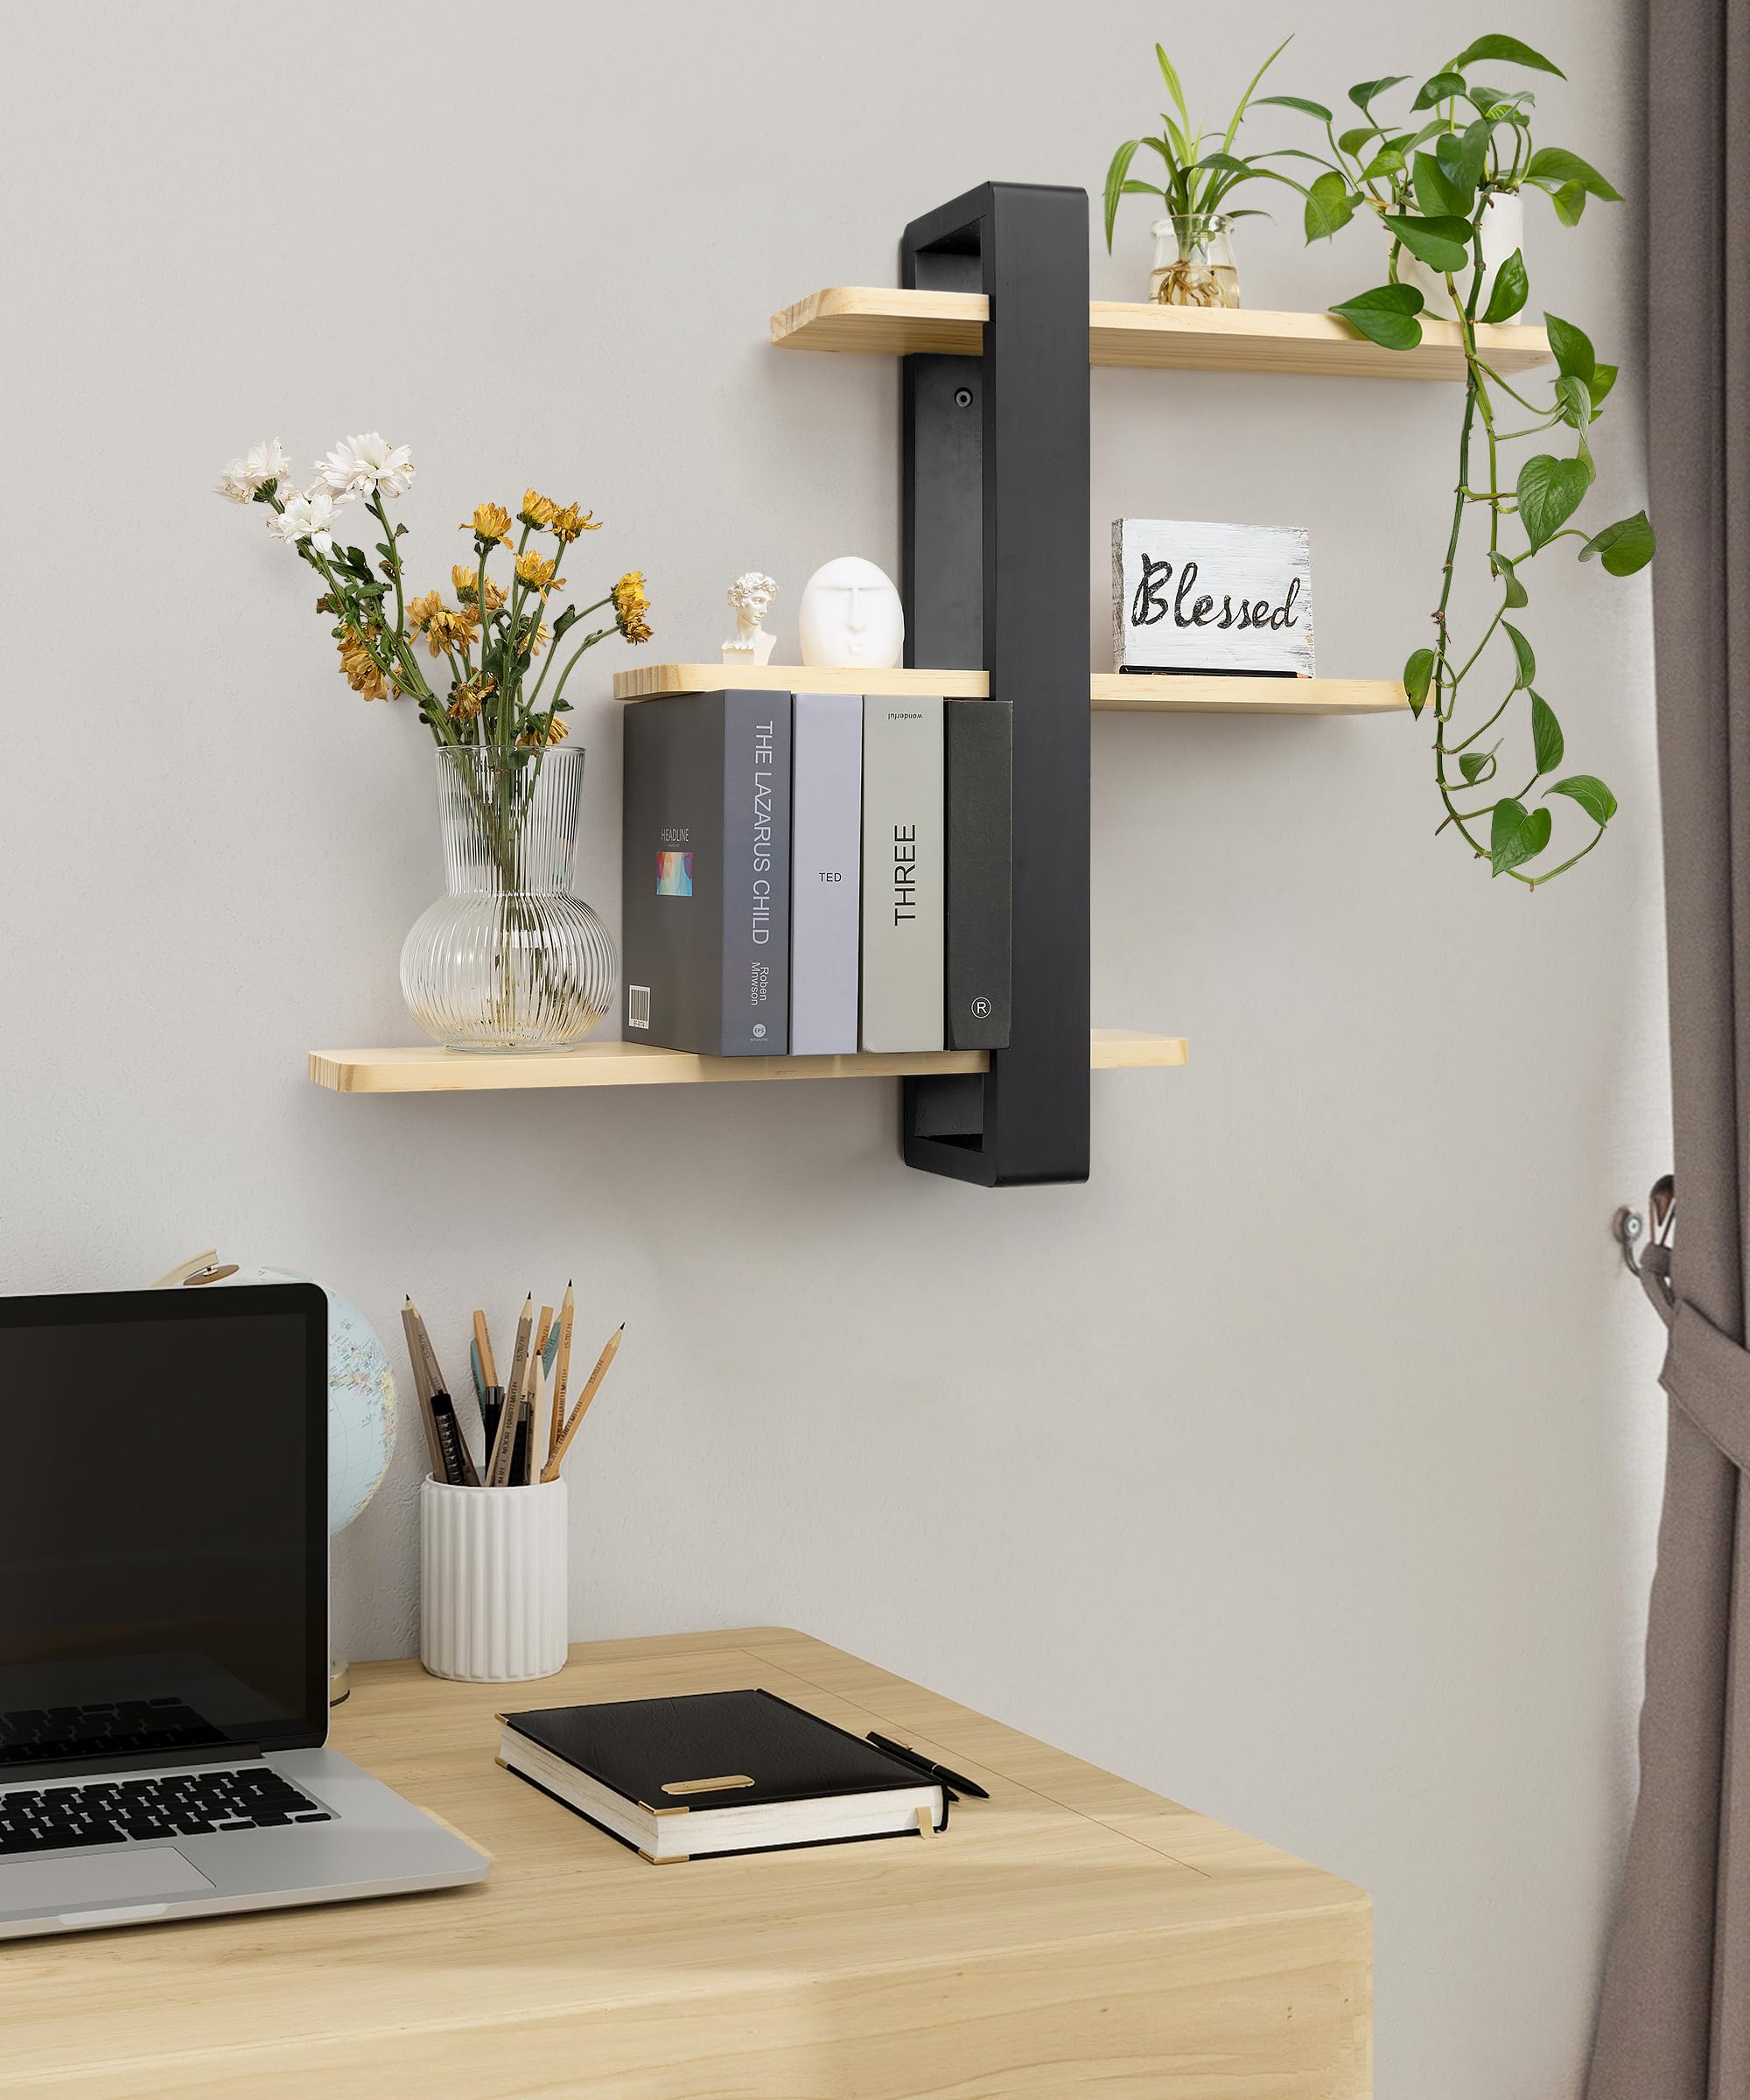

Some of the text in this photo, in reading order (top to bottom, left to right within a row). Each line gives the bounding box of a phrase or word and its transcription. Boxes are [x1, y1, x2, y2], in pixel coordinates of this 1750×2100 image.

[1131, 552, 1301, 630] Blessed
[661, 828, 690, 842] HEADLINE
[752, 720, 773, 945] THE LAZARUS CHILD
[818, 872, 842, 882] TED
[894, 824, 915, 926] THREE
[760, 966, 770, 1001] Roben
